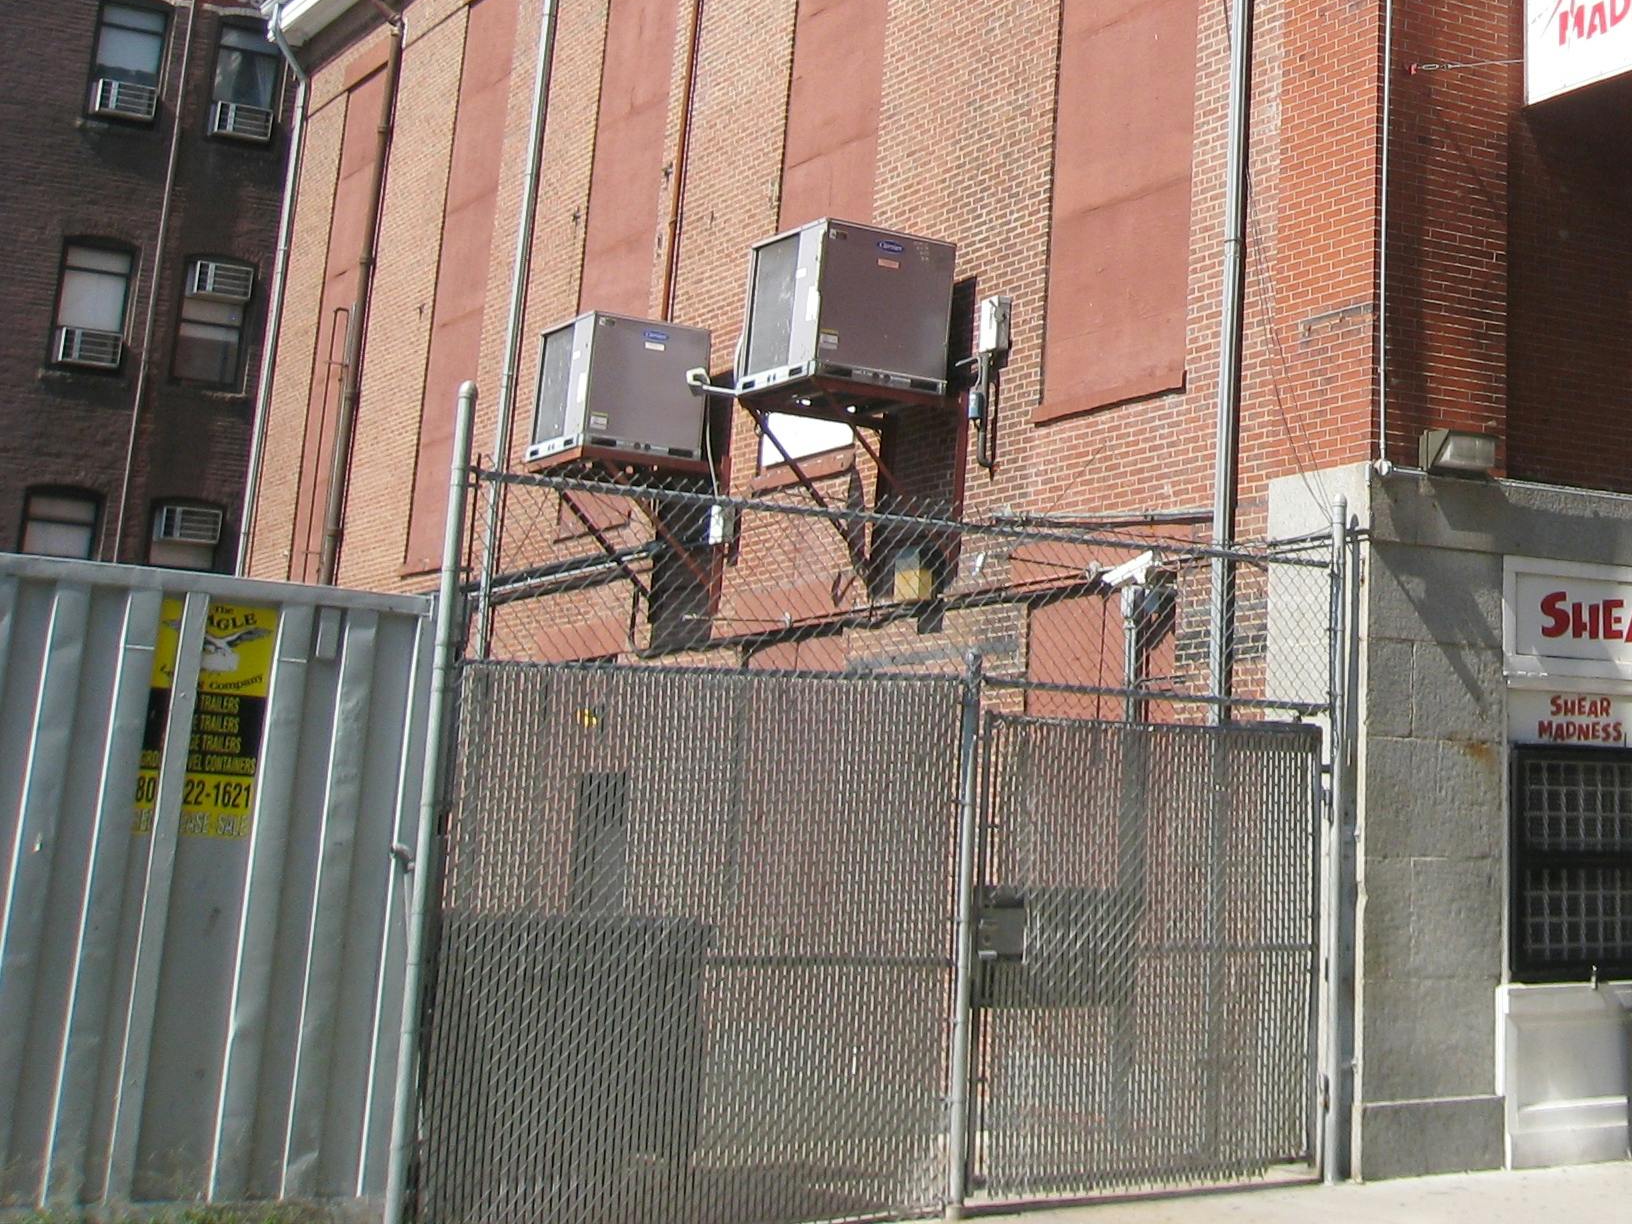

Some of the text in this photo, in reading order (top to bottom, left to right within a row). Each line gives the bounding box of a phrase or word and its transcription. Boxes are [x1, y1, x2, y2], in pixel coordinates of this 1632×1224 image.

[208, 612, 257, 631] AGLE
[200, 695, 240, 714] TRAILERS
[1550, 694, 1612, 718] SHEAR
[200, 714, 240, 734] TRAILERS
[1537, 719, 1623, 742] MADNESS
[201, 734, 242, 754] TRAILERS
[183, 778, 252, 809] 22-1621
